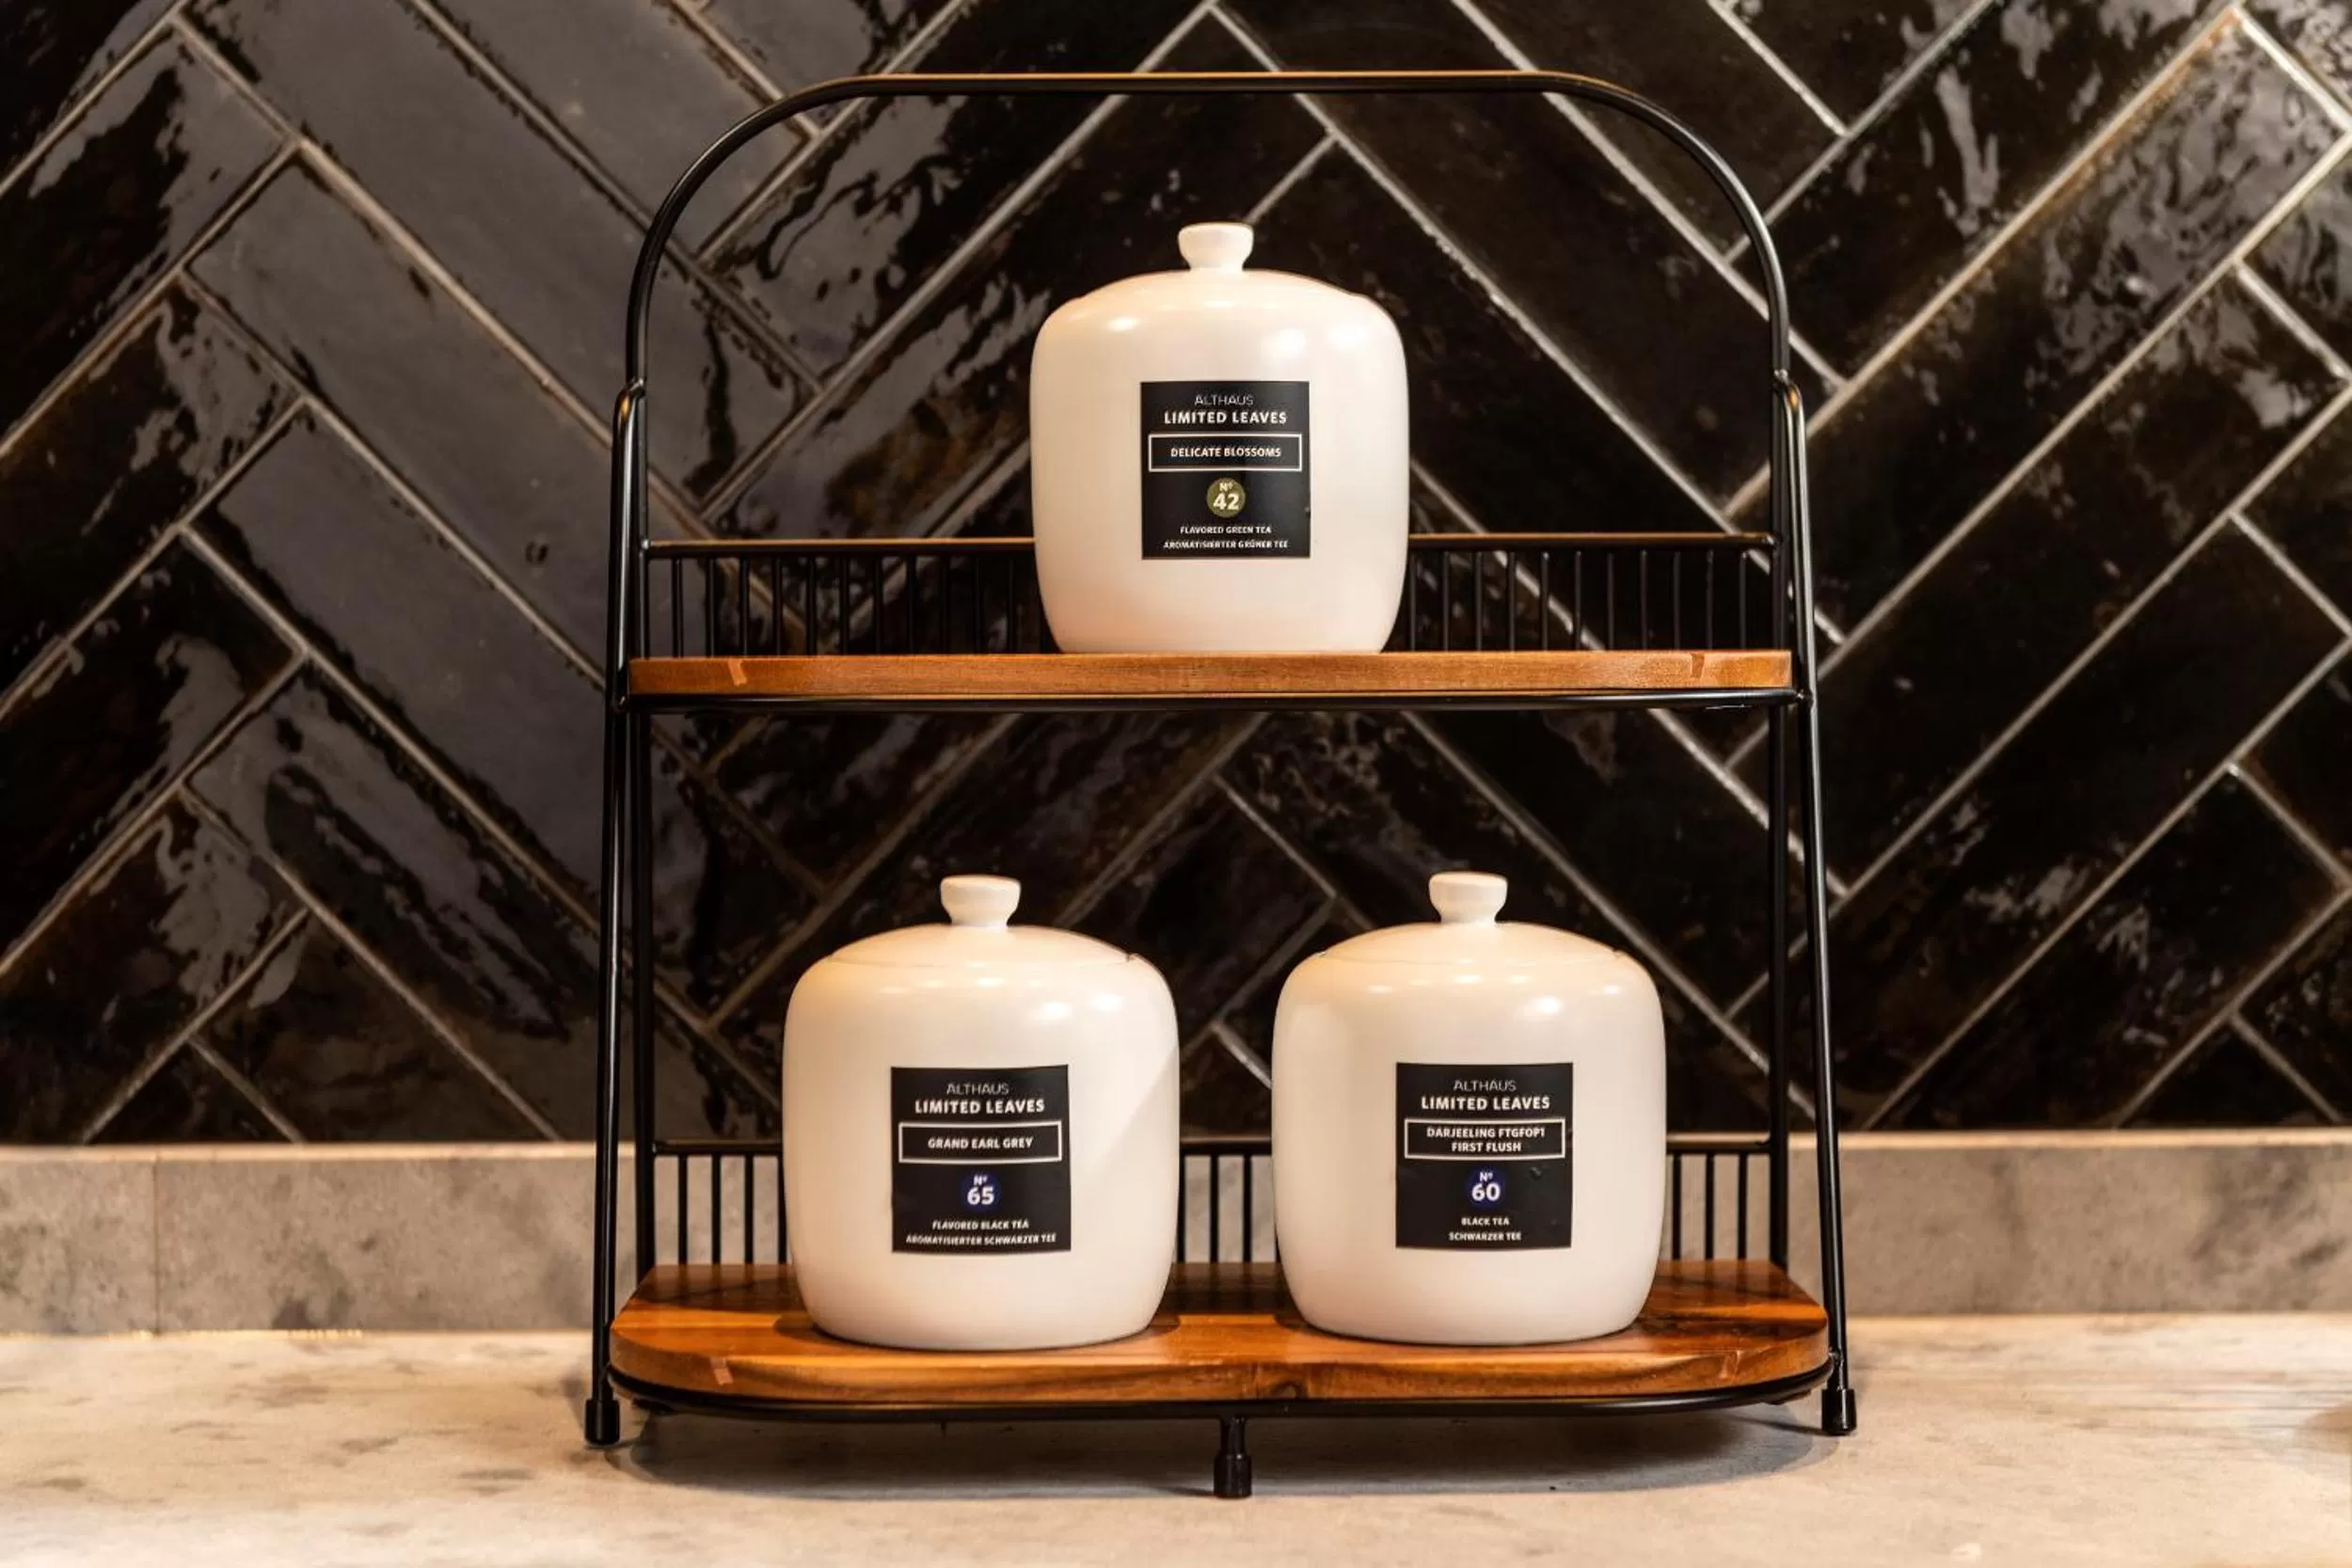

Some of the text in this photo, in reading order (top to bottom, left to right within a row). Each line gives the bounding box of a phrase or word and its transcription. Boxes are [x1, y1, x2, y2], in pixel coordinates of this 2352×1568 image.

[1195, 395, 1254, 405] ALTHAUS
[1165, 411, 1287, 424] LIMITED LEAVES
[1171, 448, 1281, 457] DELICATE BLOSSOMS
[1214, 493, 1239, 510] 42
[1238, 540, 1270, 548] GRÜNER
[946, 1084, 1009, 1095] ALTHAUS
[1454, 1080, 1517, 1092] ALTHAUS
[915, 1100, 1044, 1114] LIMITED LEAVES
[1422, 1097, 1550, 1110] LIMITED LEAVES
[1427, 1128, 1545, 1138] DARJEELING FTGFOP1
[929, 1137, 1033, 1148] GRAND EARL GREY
[1452, 1143, 1521, 1152] FIRST FLUSH
[967, 1186, 994, 1205] 65
[1472, 1183, 1501, 1201] 60
[932, 1220, 1028, 1230] FLAVORED BLACK TEA
[1461, 1217, 1509, 1226] BLACK TEA
[906, 1234, 1056, 1245] AROMATISIERTER SCHWARZER TEE
[1449, 1232, 1503, 1241] SCHWARZER
